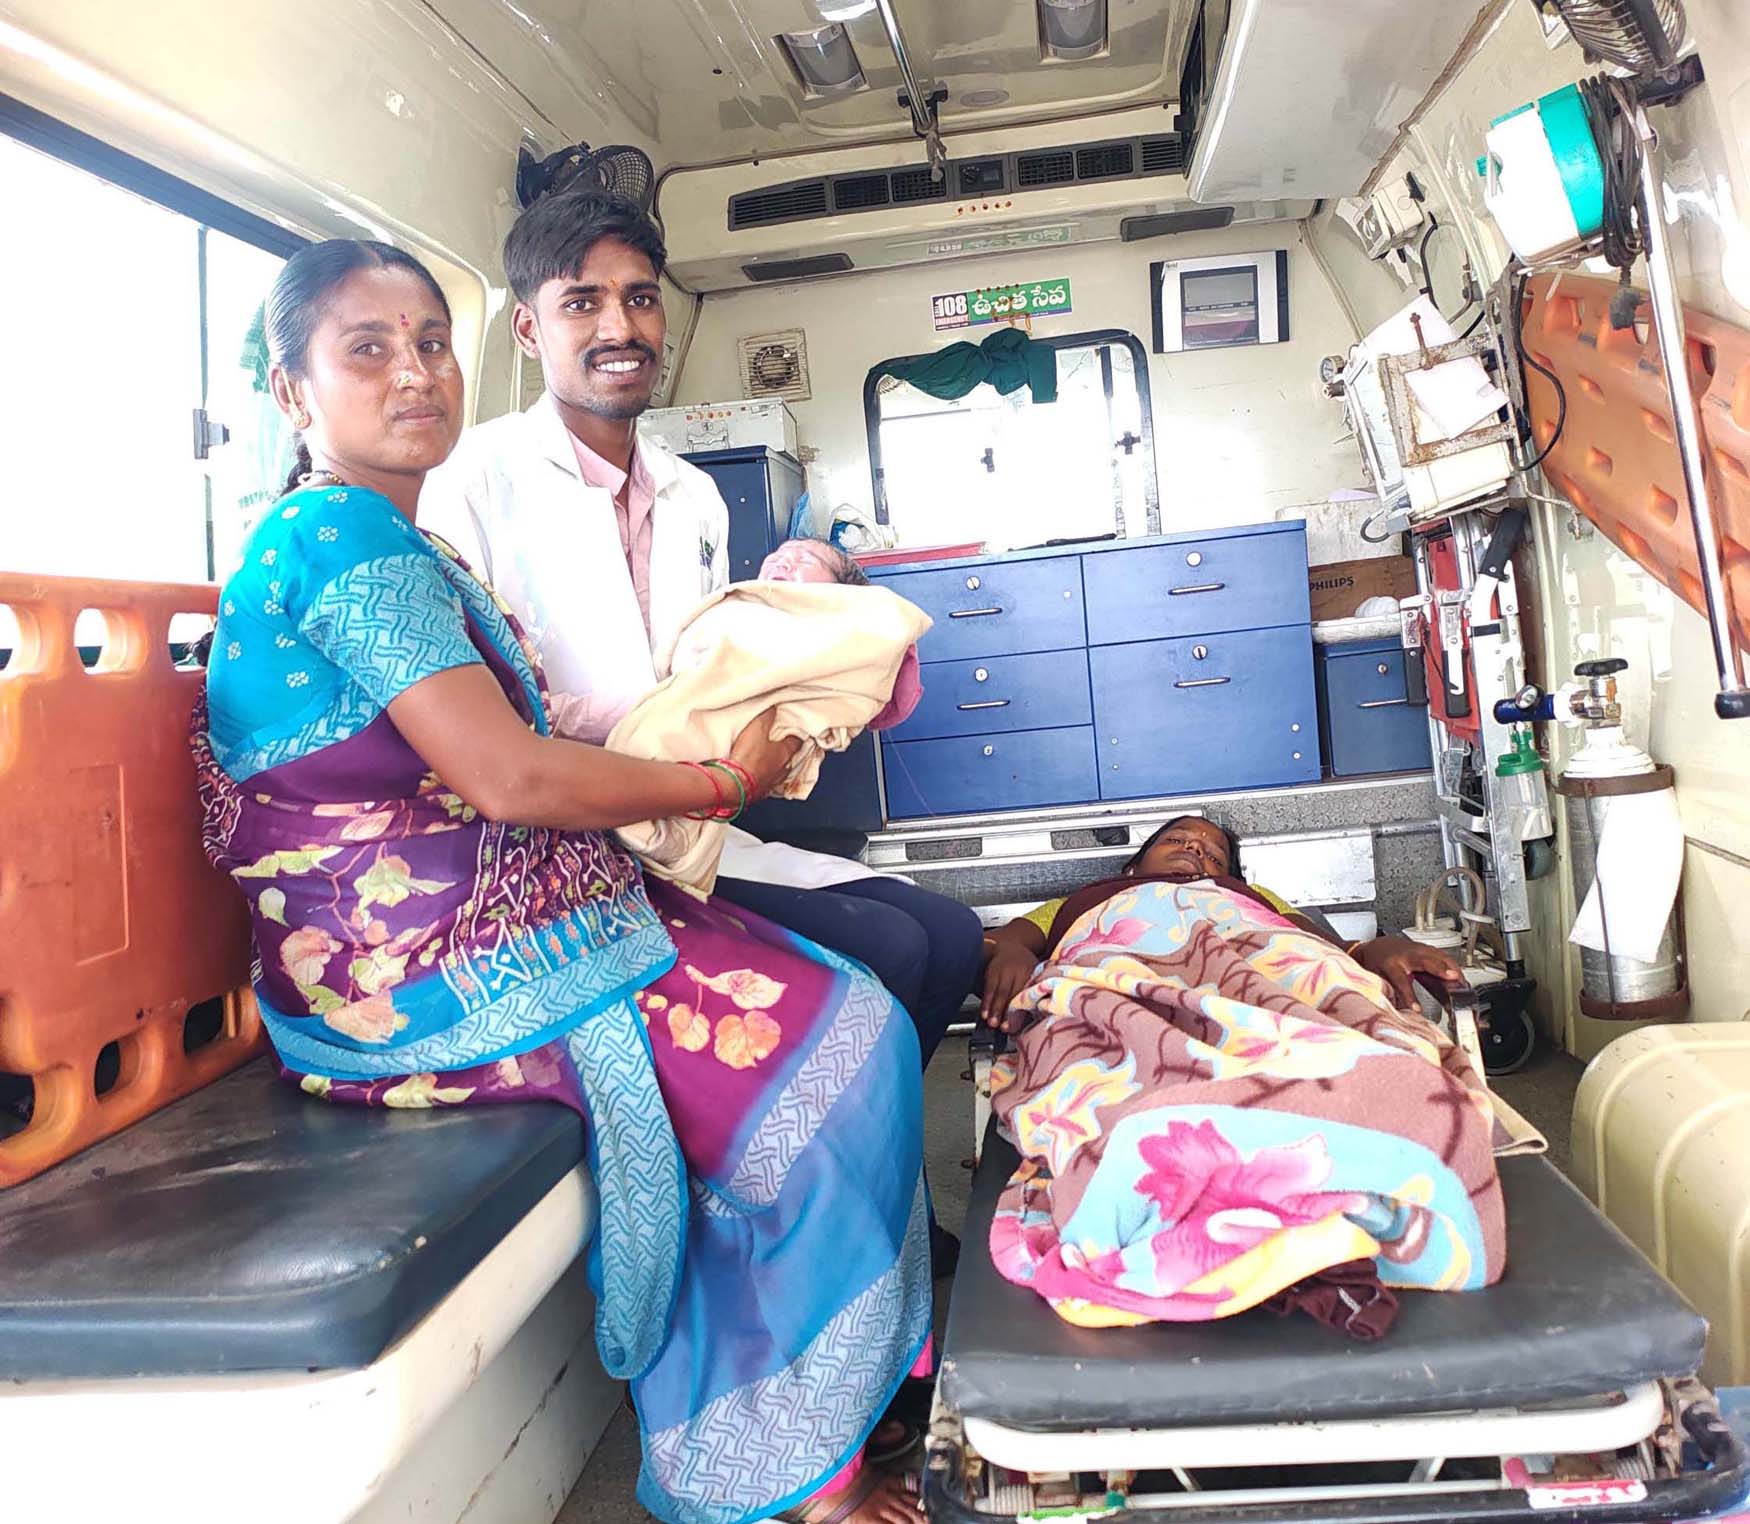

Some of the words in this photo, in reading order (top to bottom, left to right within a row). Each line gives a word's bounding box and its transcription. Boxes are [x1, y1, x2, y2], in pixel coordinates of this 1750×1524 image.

[935, 295, 967, 317] 108
[1031, 285, 1067, 306] సేవ
[1309, 576, 1354, 591] PHILIPS
